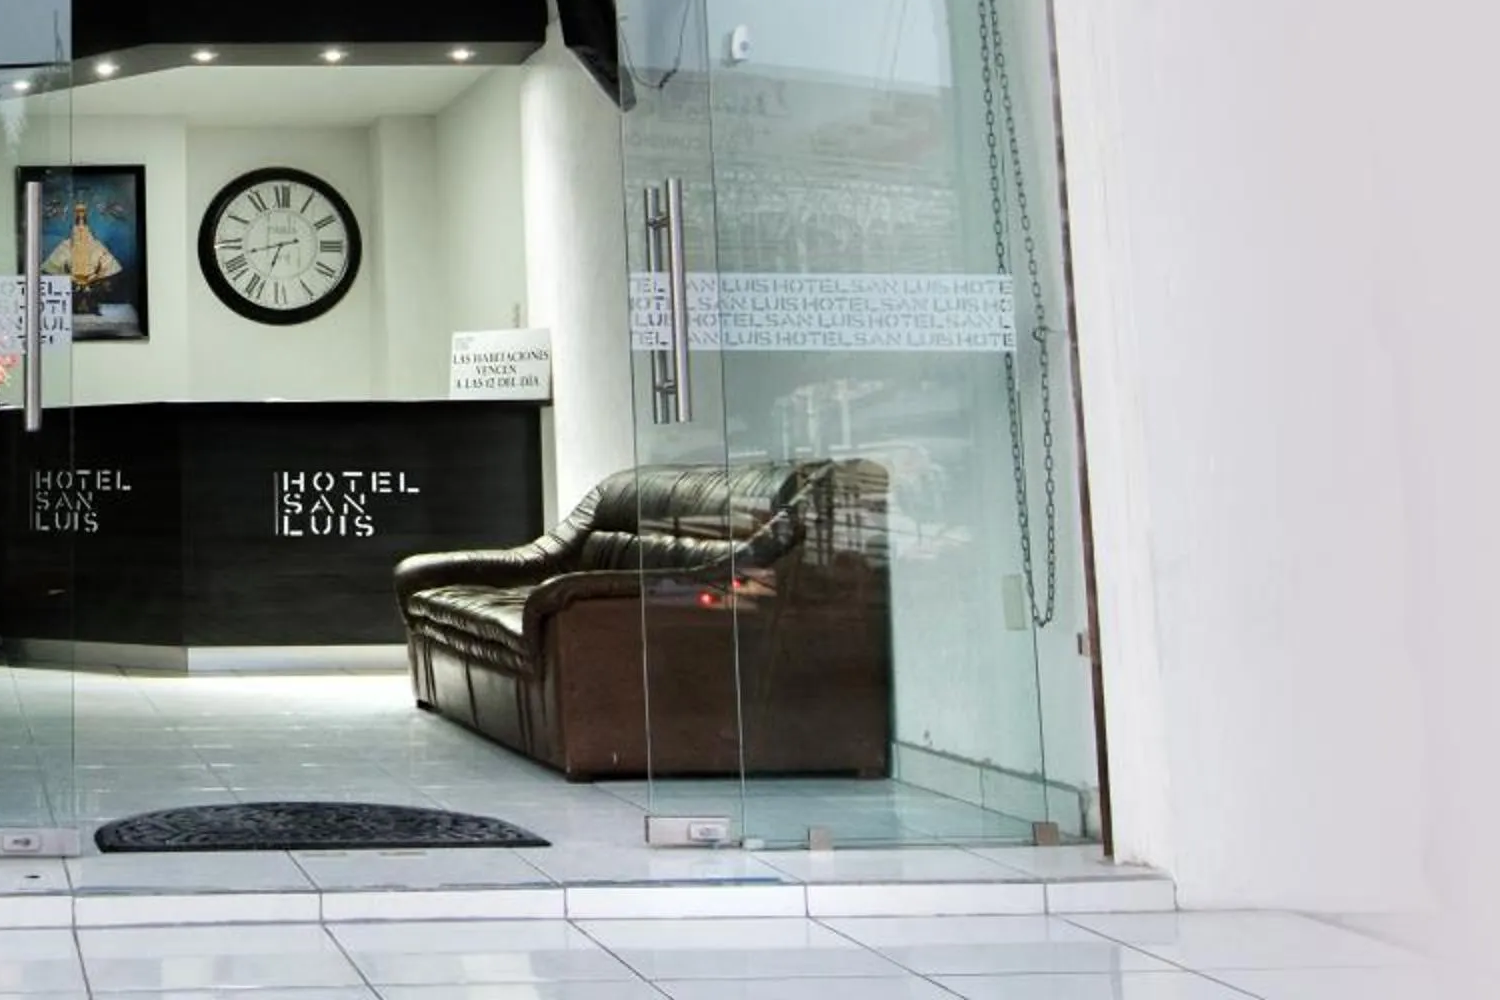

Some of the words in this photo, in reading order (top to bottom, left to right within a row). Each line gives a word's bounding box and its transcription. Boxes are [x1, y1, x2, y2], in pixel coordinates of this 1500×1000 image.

[453, 353, 471, 364] LAS
[35, 469, 132, 491] HOTEL
[283, 471, 420, 493] HOTEL
[36, 491, 93, 511] SAN
[283, 493, 366, 514] SAN
[35, 511, 99, 533] LUIS
[283, 515, 375, 537] LUIS
